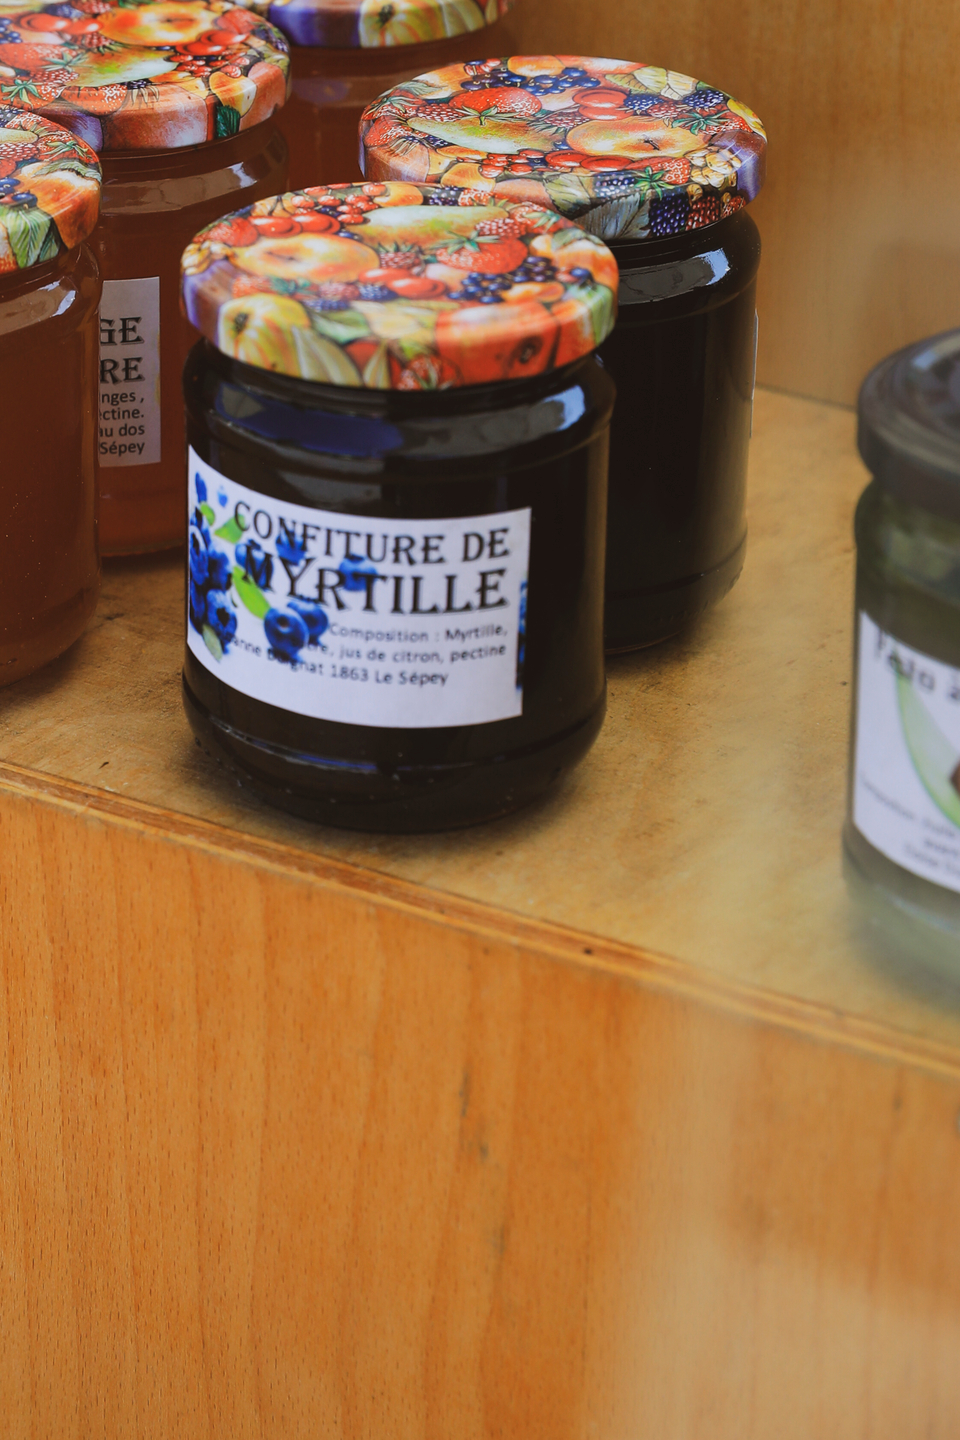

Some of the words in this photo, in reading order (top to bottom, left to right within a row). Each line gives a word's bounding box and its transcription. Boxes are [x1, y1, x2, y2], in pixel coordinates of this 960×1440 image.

[99, 391, 136, 407] nges
[118, 423, 145, 437] dos
[100, 439, 145, 457] Sépey
[233, 500, 445, 567] CONFITURE
[461, 528, 511, 563] DE
[241, 544, 511, 616] MYRTILLE
[328, 622, 429, 643] Composition
[444, 624, 508, 644] Myrtille,
[340, 644, 362, 660] jus
[367, 649, 386, 662] de
[392, 651, 445, 665] citron,
[450, 644, 507, 665] pectine
[331, 664, 370, 682] 1863
[375, 670, 393, 684] Le
[398, 670, 450, 688] Sépey
